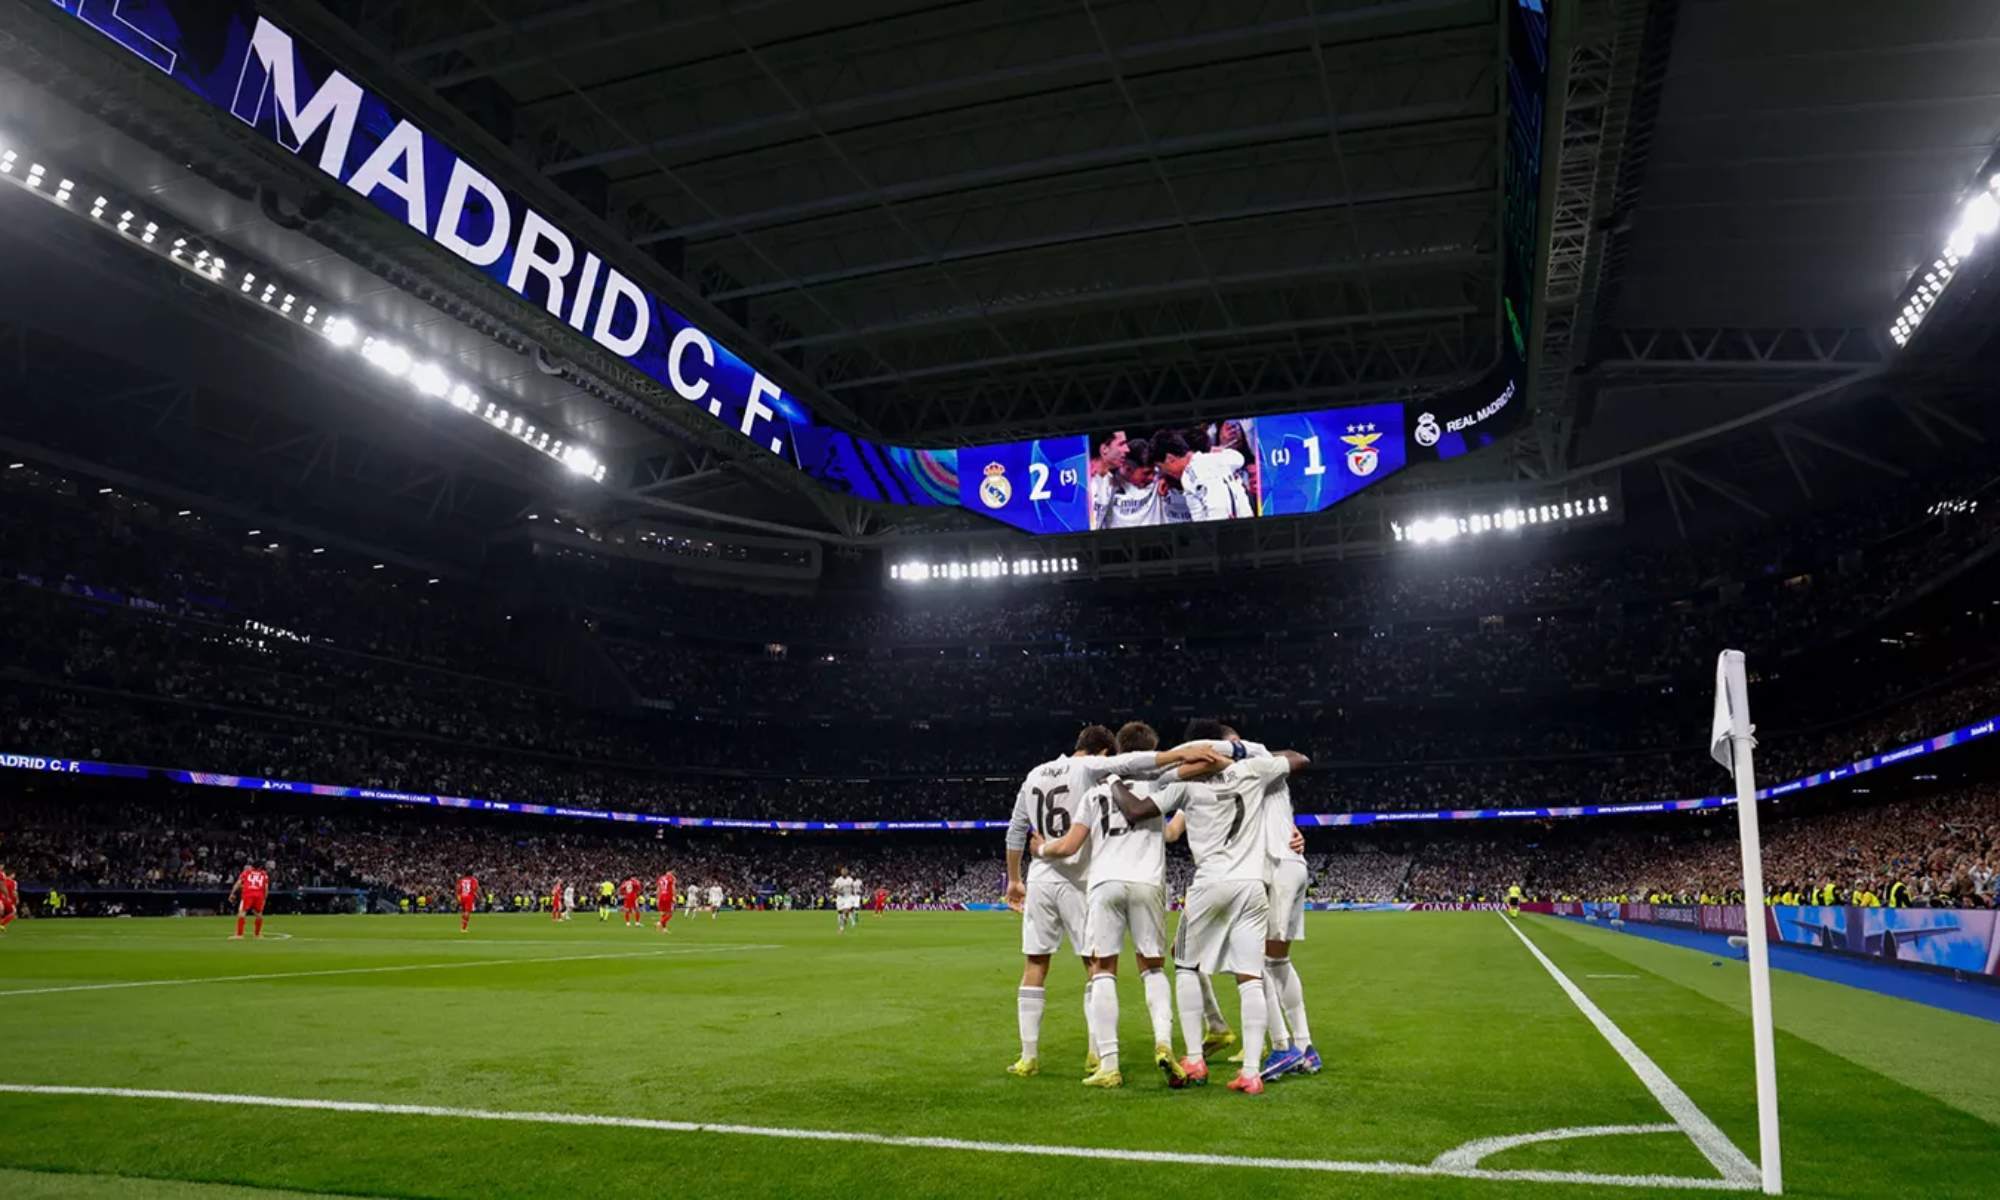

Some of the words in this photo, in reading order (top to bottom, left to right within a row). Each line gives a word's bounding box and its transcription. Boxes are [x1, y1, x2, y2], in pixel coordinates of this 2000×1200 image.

[231, 16, 650, 358] MADRID
[668, 327, 722, 417] C.
[740, 372, 782, 455] F.
[1446, 414, 1477, 433] REAL
[1271, 447, 1291, 467] (1)
[1303, 435, 1326, 476] 1
[1029, 462, 1052, 501] 2
[50, 759, 65, 772] C.
[69, 761, 80, 773] F.
[1032, 784, 1071, 841] 16
[1215, 792, 1245, 846] 7
[247, 874, 265, 888] 44
[1422, 903, 1463, 912] QATAR
